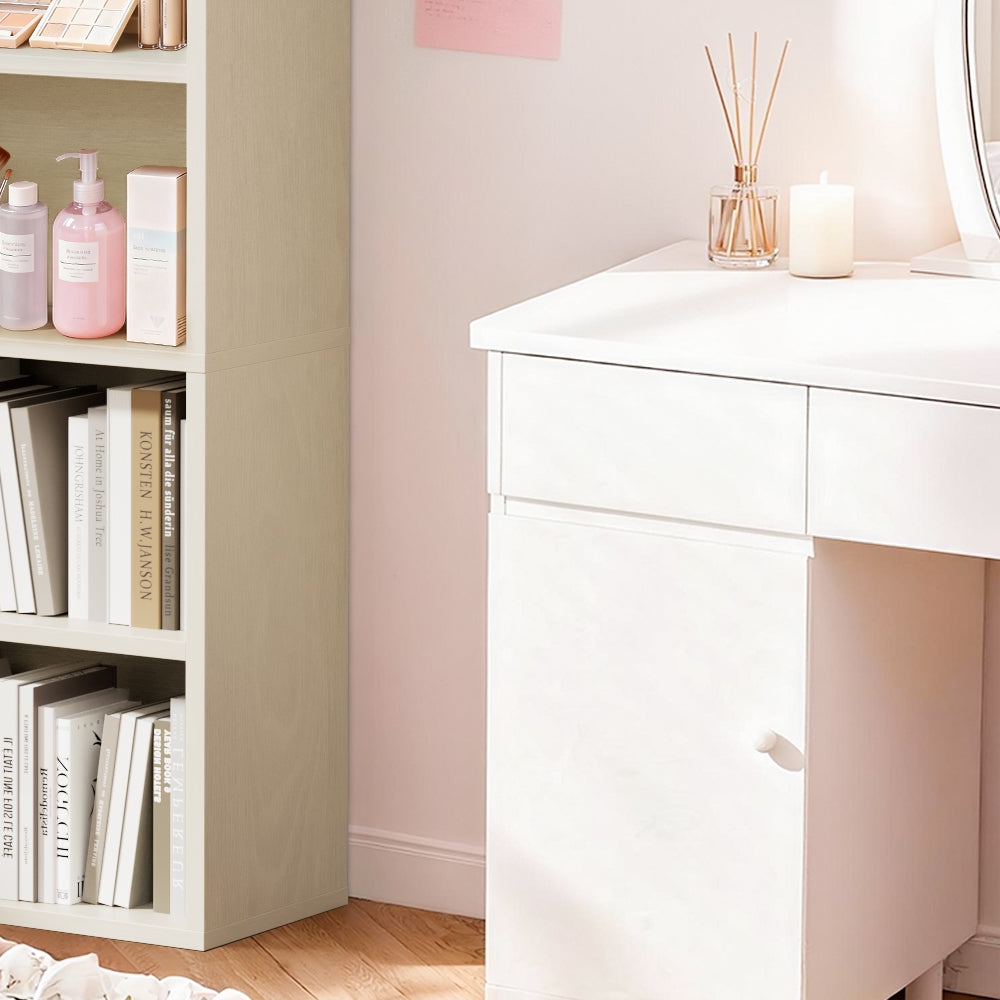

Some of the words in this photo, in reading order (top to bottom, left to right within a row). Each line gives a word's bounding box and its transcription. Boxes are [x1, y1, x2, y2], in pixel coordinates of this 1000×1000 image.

[164, 398, 173, 426] saum
[95, 429, 105, 441] At
[164, 428, 176, 446] für
[95, 444, 105, 474] Home
[139, 430, 153, 499] KONSTEN
[164, 448, 176, 468] alla
[95, 476, 104, 486] in
[164, 470, 176, 488] die
[92, 488, 105, 522] Joshua
[164, 490, 176, 537] sünderin
[95, 525, 105, 548] Tree
